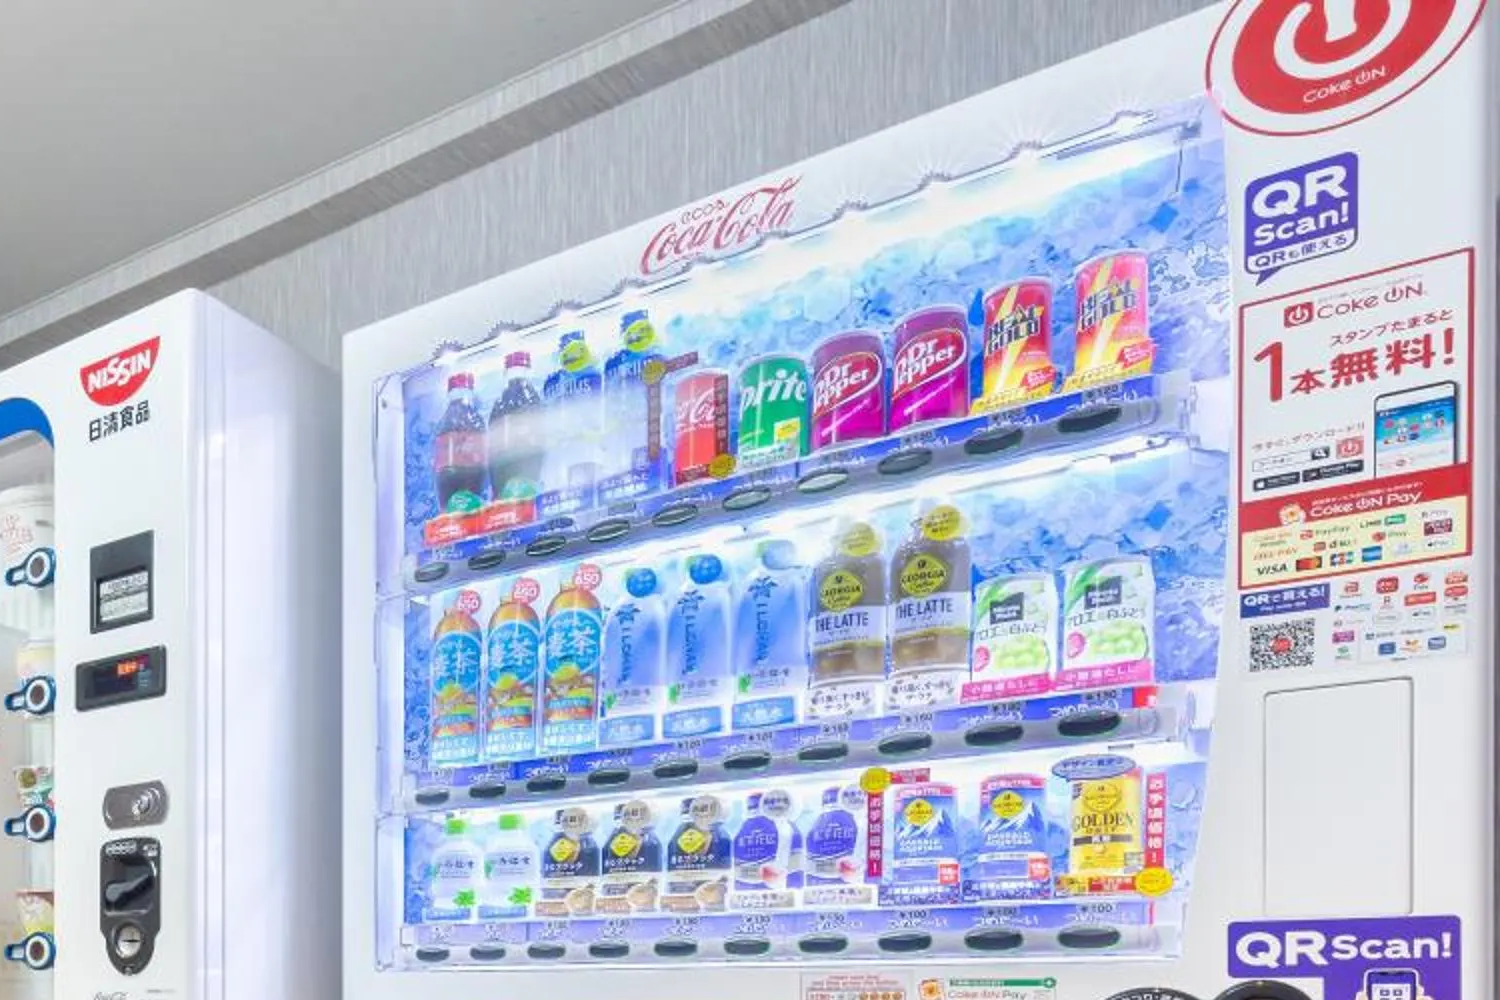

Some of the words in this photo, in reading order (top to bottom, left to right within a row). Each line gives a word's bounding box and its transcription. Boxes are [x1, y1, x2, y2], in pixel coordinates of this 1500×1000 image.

[1252, 164, 1349, 219] QR
[640, 174, 804, 276] Coca-Cola
[1253, 201, 1349, 247] Scan!
[1254, 233, 1348, 269] QRも使える
[1330, 308, 1454, 348] スタンプたまると
[908, 338, 940, 363] Dr
[1253, 327, 1455, 403] 1本無料!
[87, 348, 152, 393] NISSIN
[740, 367, 808, 412] prite
[824, 362, 853, 386] Dr
[88, 399, 151, 442] 日清食品
[1386, 490, 1423, 507] Pay
[1256, 562, 1288, 577] VISA
[833, 611, 869, 630] LATTE
[917, 597, 954, 615] LATTE
[1071, 810, 1137, 834] GOLDEN
[1235, 930, 1329, 969] QR
[1331, 931, 1453, 960] Scan!
